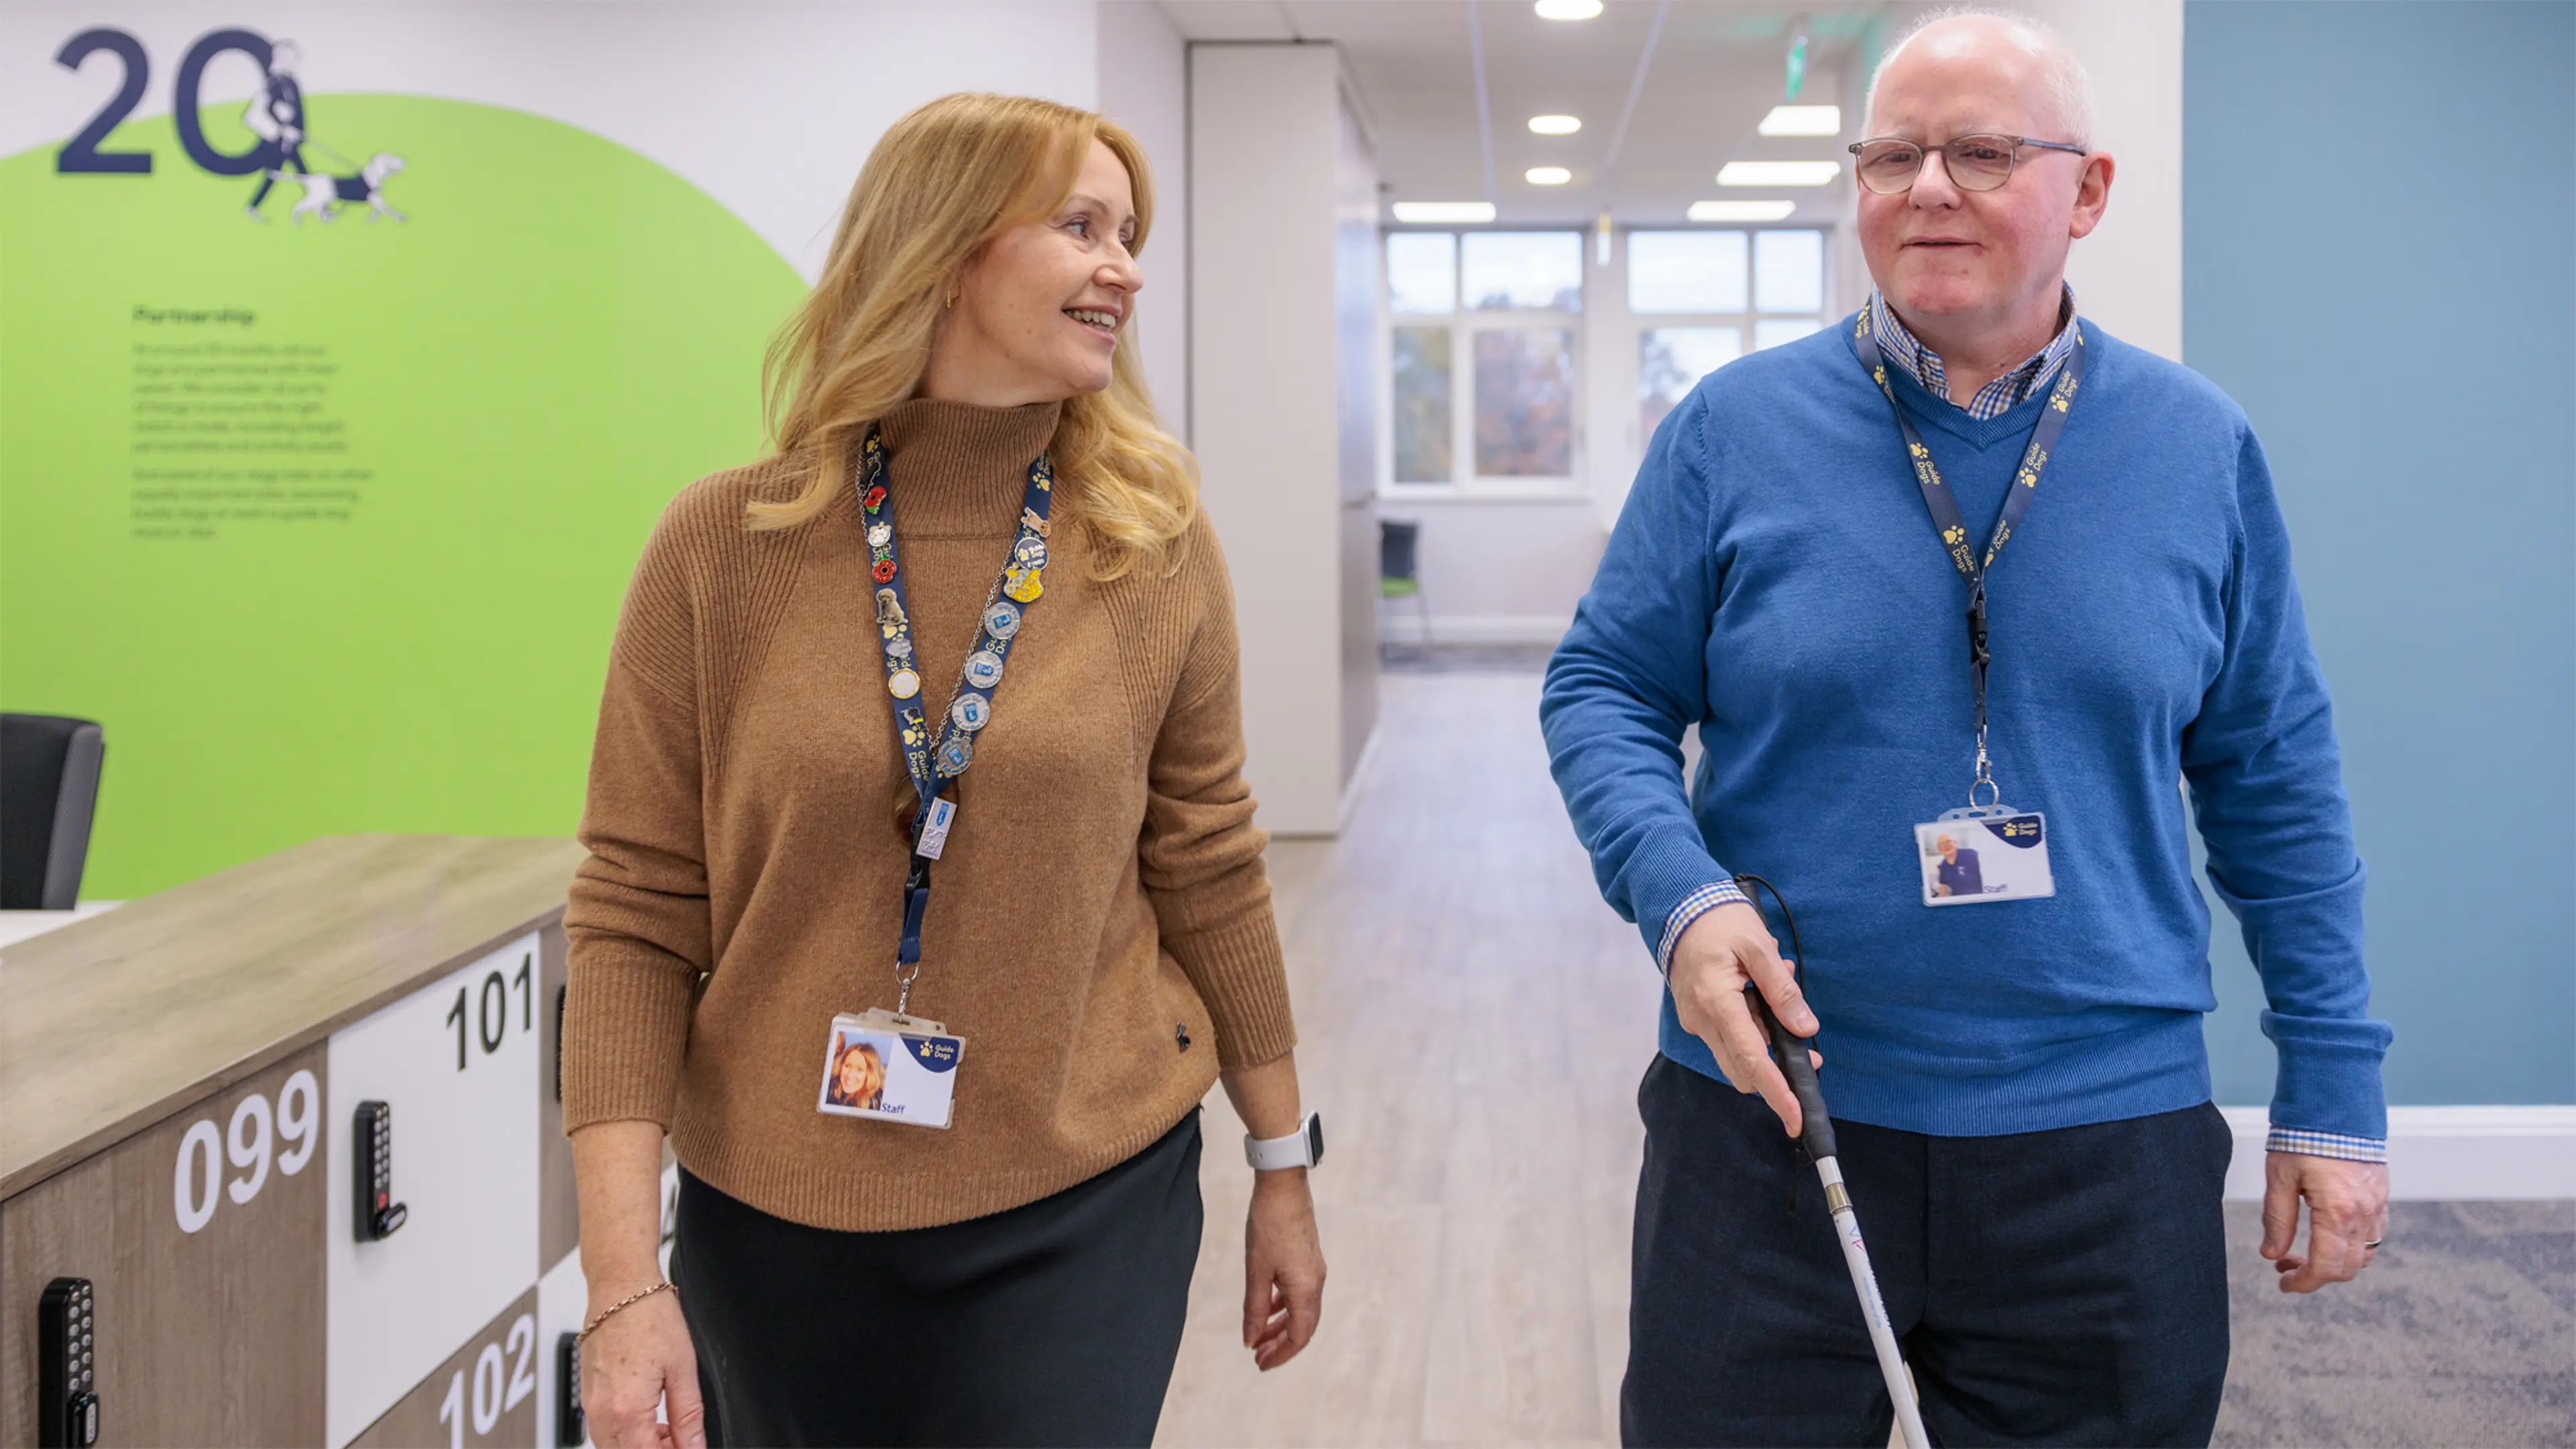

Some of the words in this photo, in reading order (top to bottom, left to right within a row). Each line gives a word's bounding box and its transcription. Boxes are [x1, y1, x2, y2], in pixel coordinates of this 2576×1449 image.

[54, 28, 275, 175] 20
[2057, 370, 2072, 392] Guide
[2064, 378, 2077, 397] Dogs
[2027, 443, 2041, 466] Guide
[2033, 450, 2047, 471] Dogs
[1917, 462, 1930, 484] Dogs
[1925, 461, 1940, 485] Guide
[1995, 528, 2010, 549] Dogs
[1952, 548, 1967, 572] Dogs
[1960, 544, 1974, 571] Guide
[909, 752, 921, 778] Dogs
[918, 751, 929, 781] Guide
[445, 951, 531, 1073] 101
[934, 1051, 951, 1060] Dogs
[935, 1044, 954, 1053] Guide
[882, 1103, 906, 1115] Staff
[174, 1069, 320, 1234] 099
[439, 1313, 535, 1449] 102
